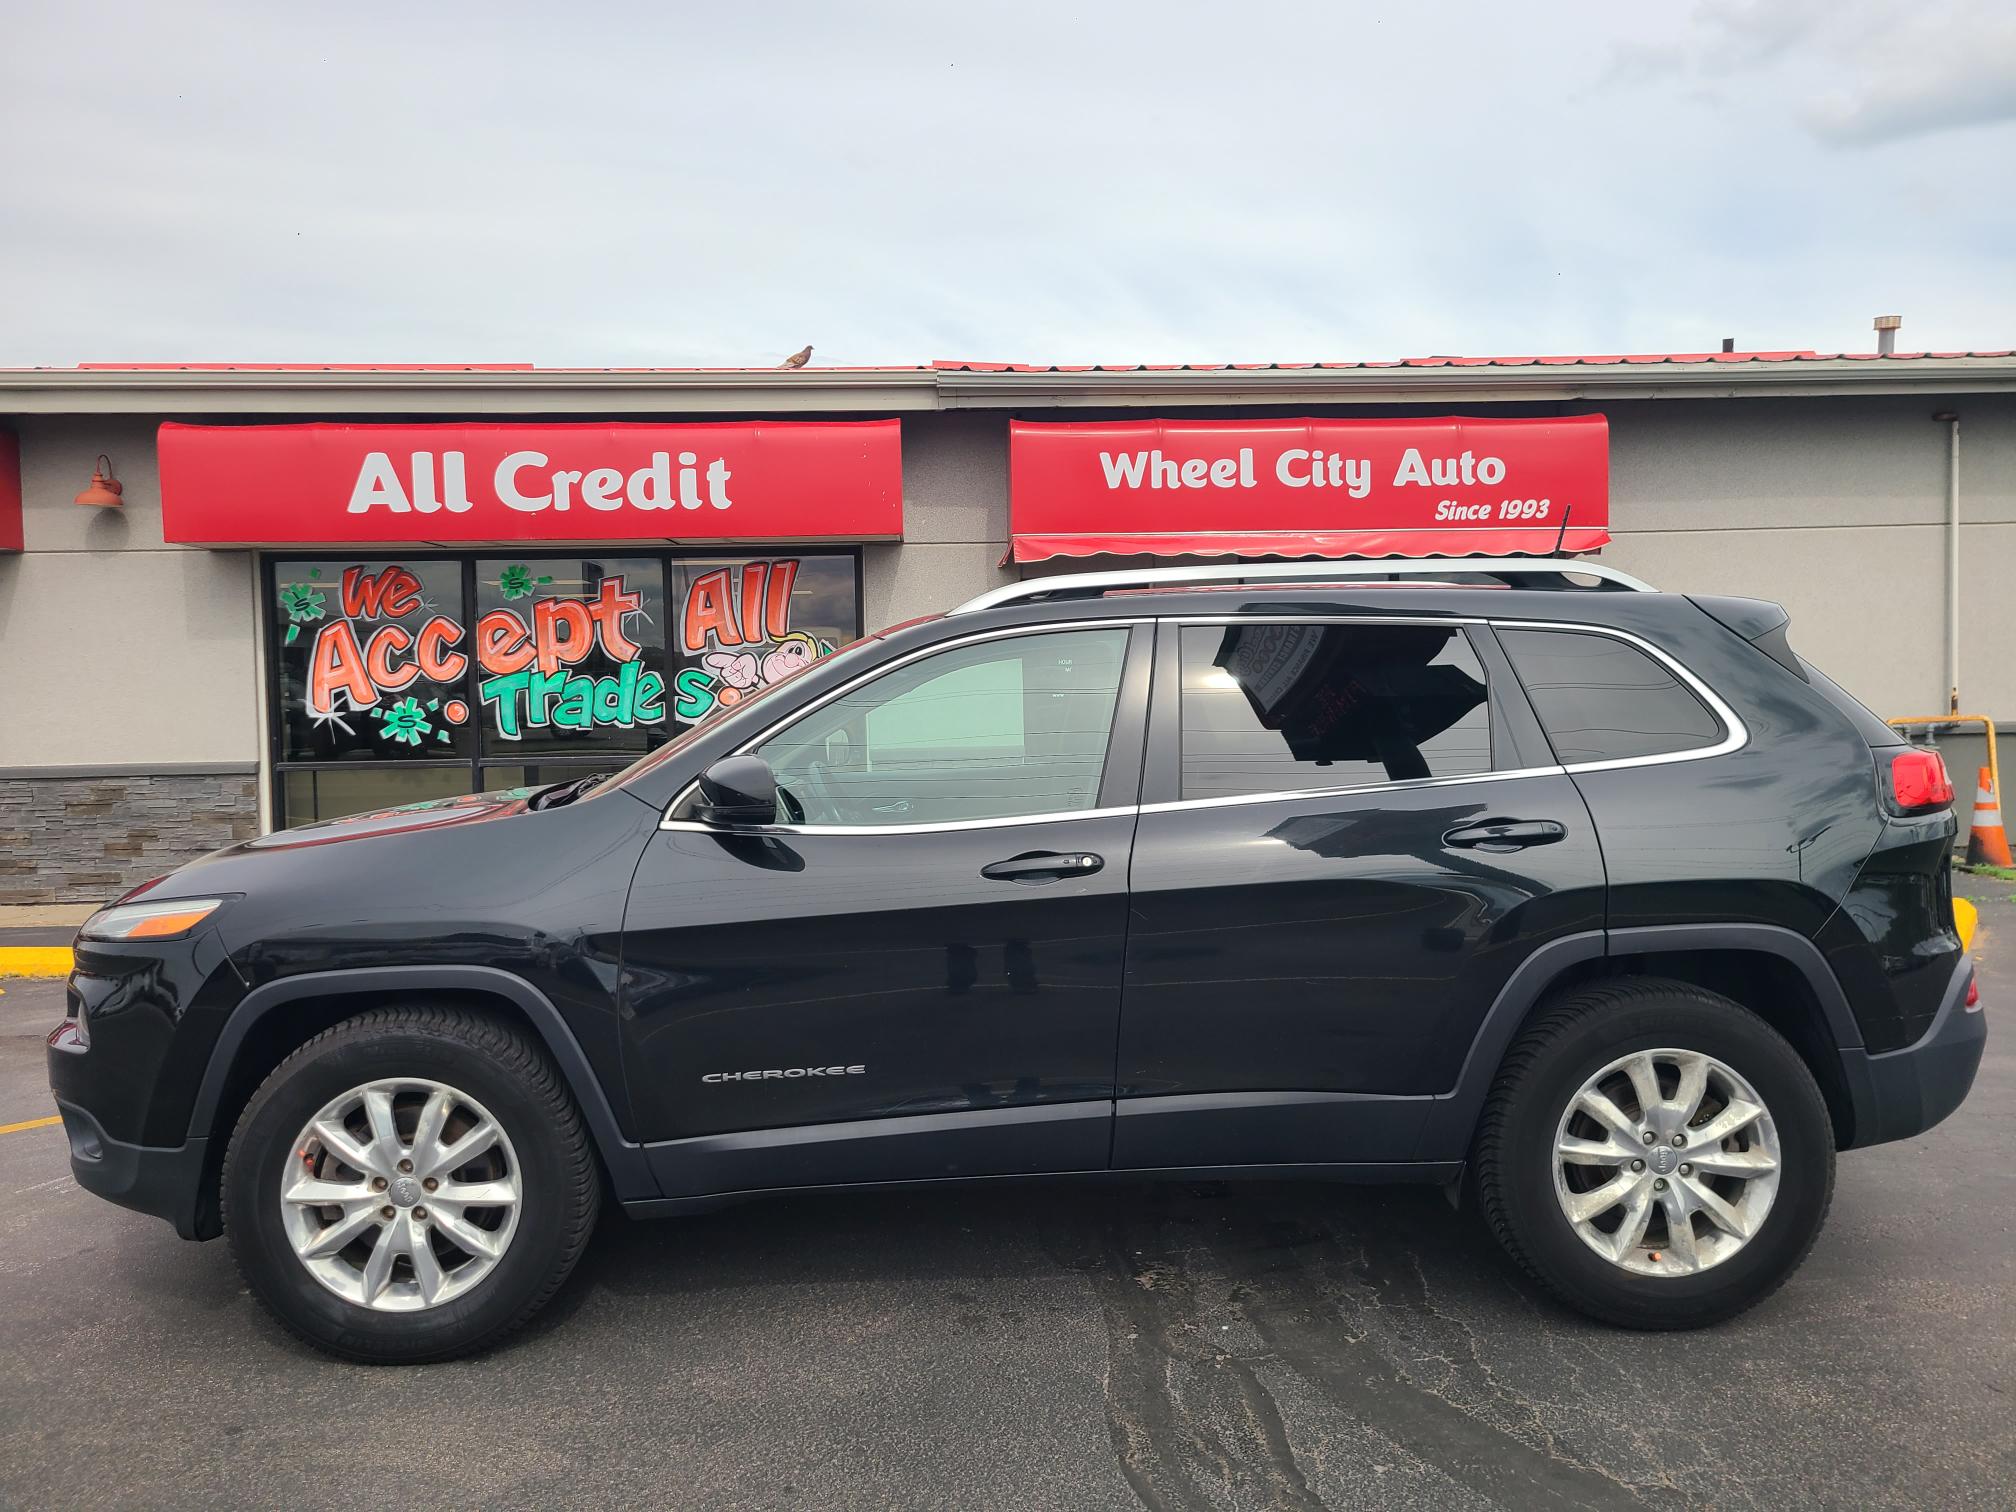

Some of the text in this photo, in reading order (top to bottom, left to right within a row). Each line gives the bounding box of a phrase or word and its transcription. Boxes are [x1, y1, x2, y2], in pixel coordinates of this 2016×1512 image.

[347, 450, 733, 514] All Credit
[1099, 447, 1507, 499] Wheel City Auto
[1434, 499, 1551, 521] Since 1993
[340, 564, 424, 620] We
[308, 559, 800, 716] Accept All
[481, 660, 716, 738] Trades
[701, 1064, 866, 1084] CHEROKEE
